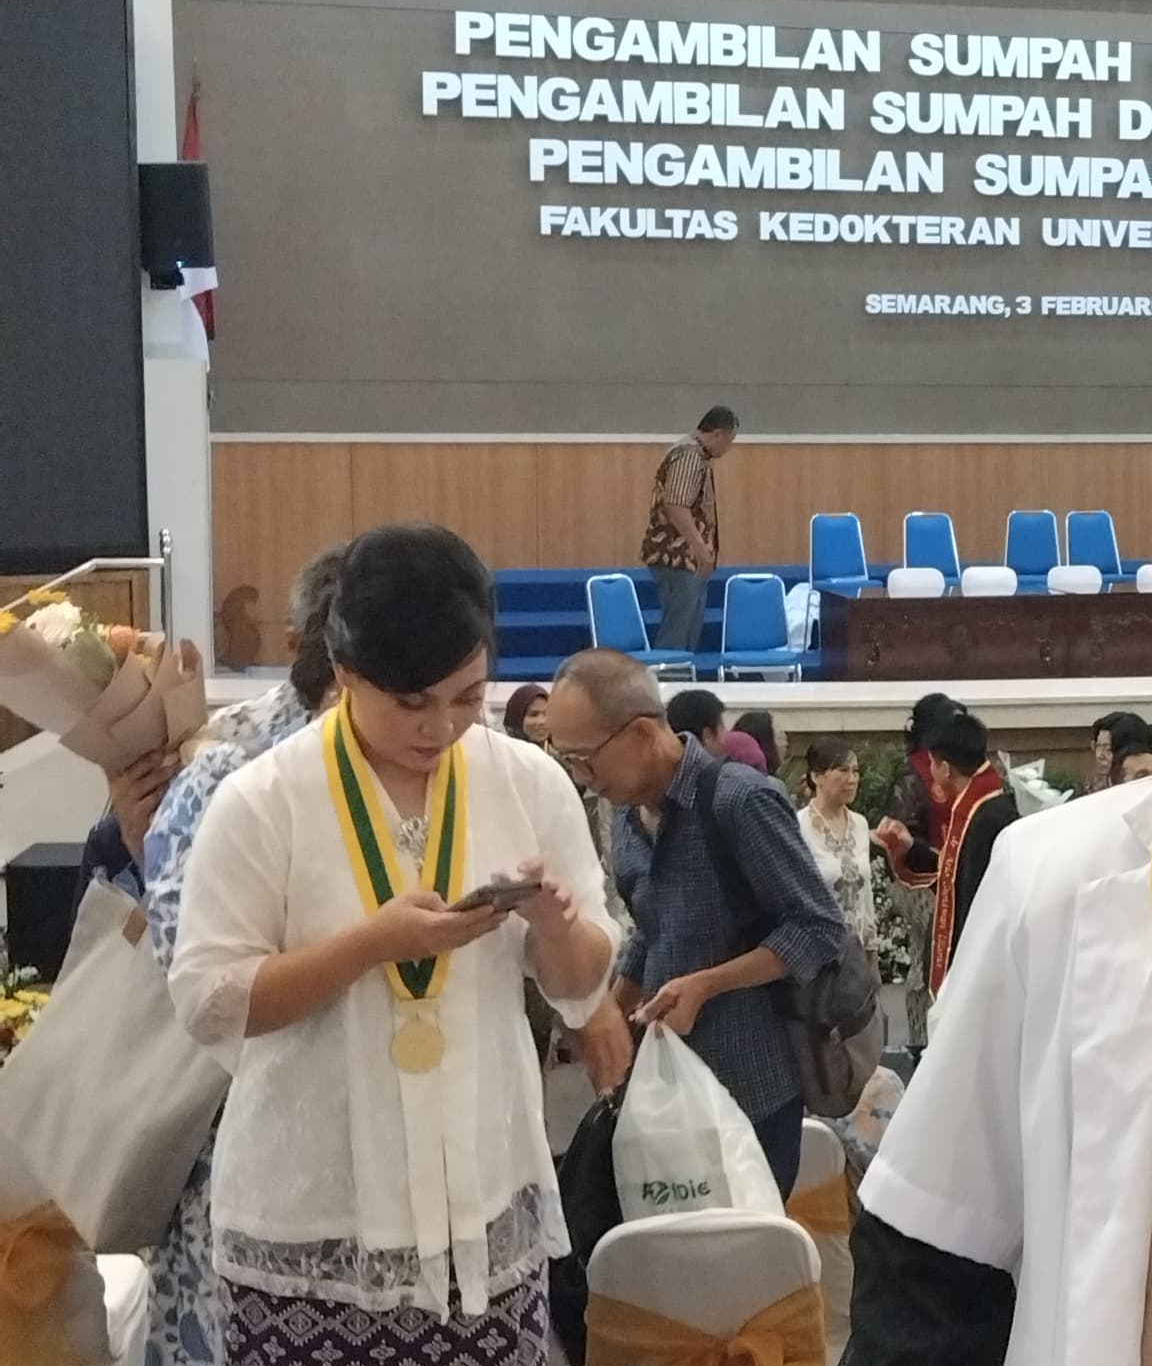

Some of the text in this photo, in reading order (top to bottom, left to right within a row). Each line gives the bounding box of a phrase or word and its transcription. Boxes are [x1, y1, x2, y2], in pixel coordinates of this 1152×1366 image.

[455, 10, 881, 73] PENGAMBILAN
[908, 33, 1132, 83] SUMPAH
[421, 71, 845, 131] PENGAMBILAN
[870, 90, 1093, 139] SUMPAH
[529, 138, 944, 193] PENGAMBILAN
[540, 205, 739, 241] FAKULTAS
[759, 211, 1020, 246] KEDOKTERAN
[865, 293, 1011, 318] SEMARANG,
[1015, 295, 1032, 316] 3
